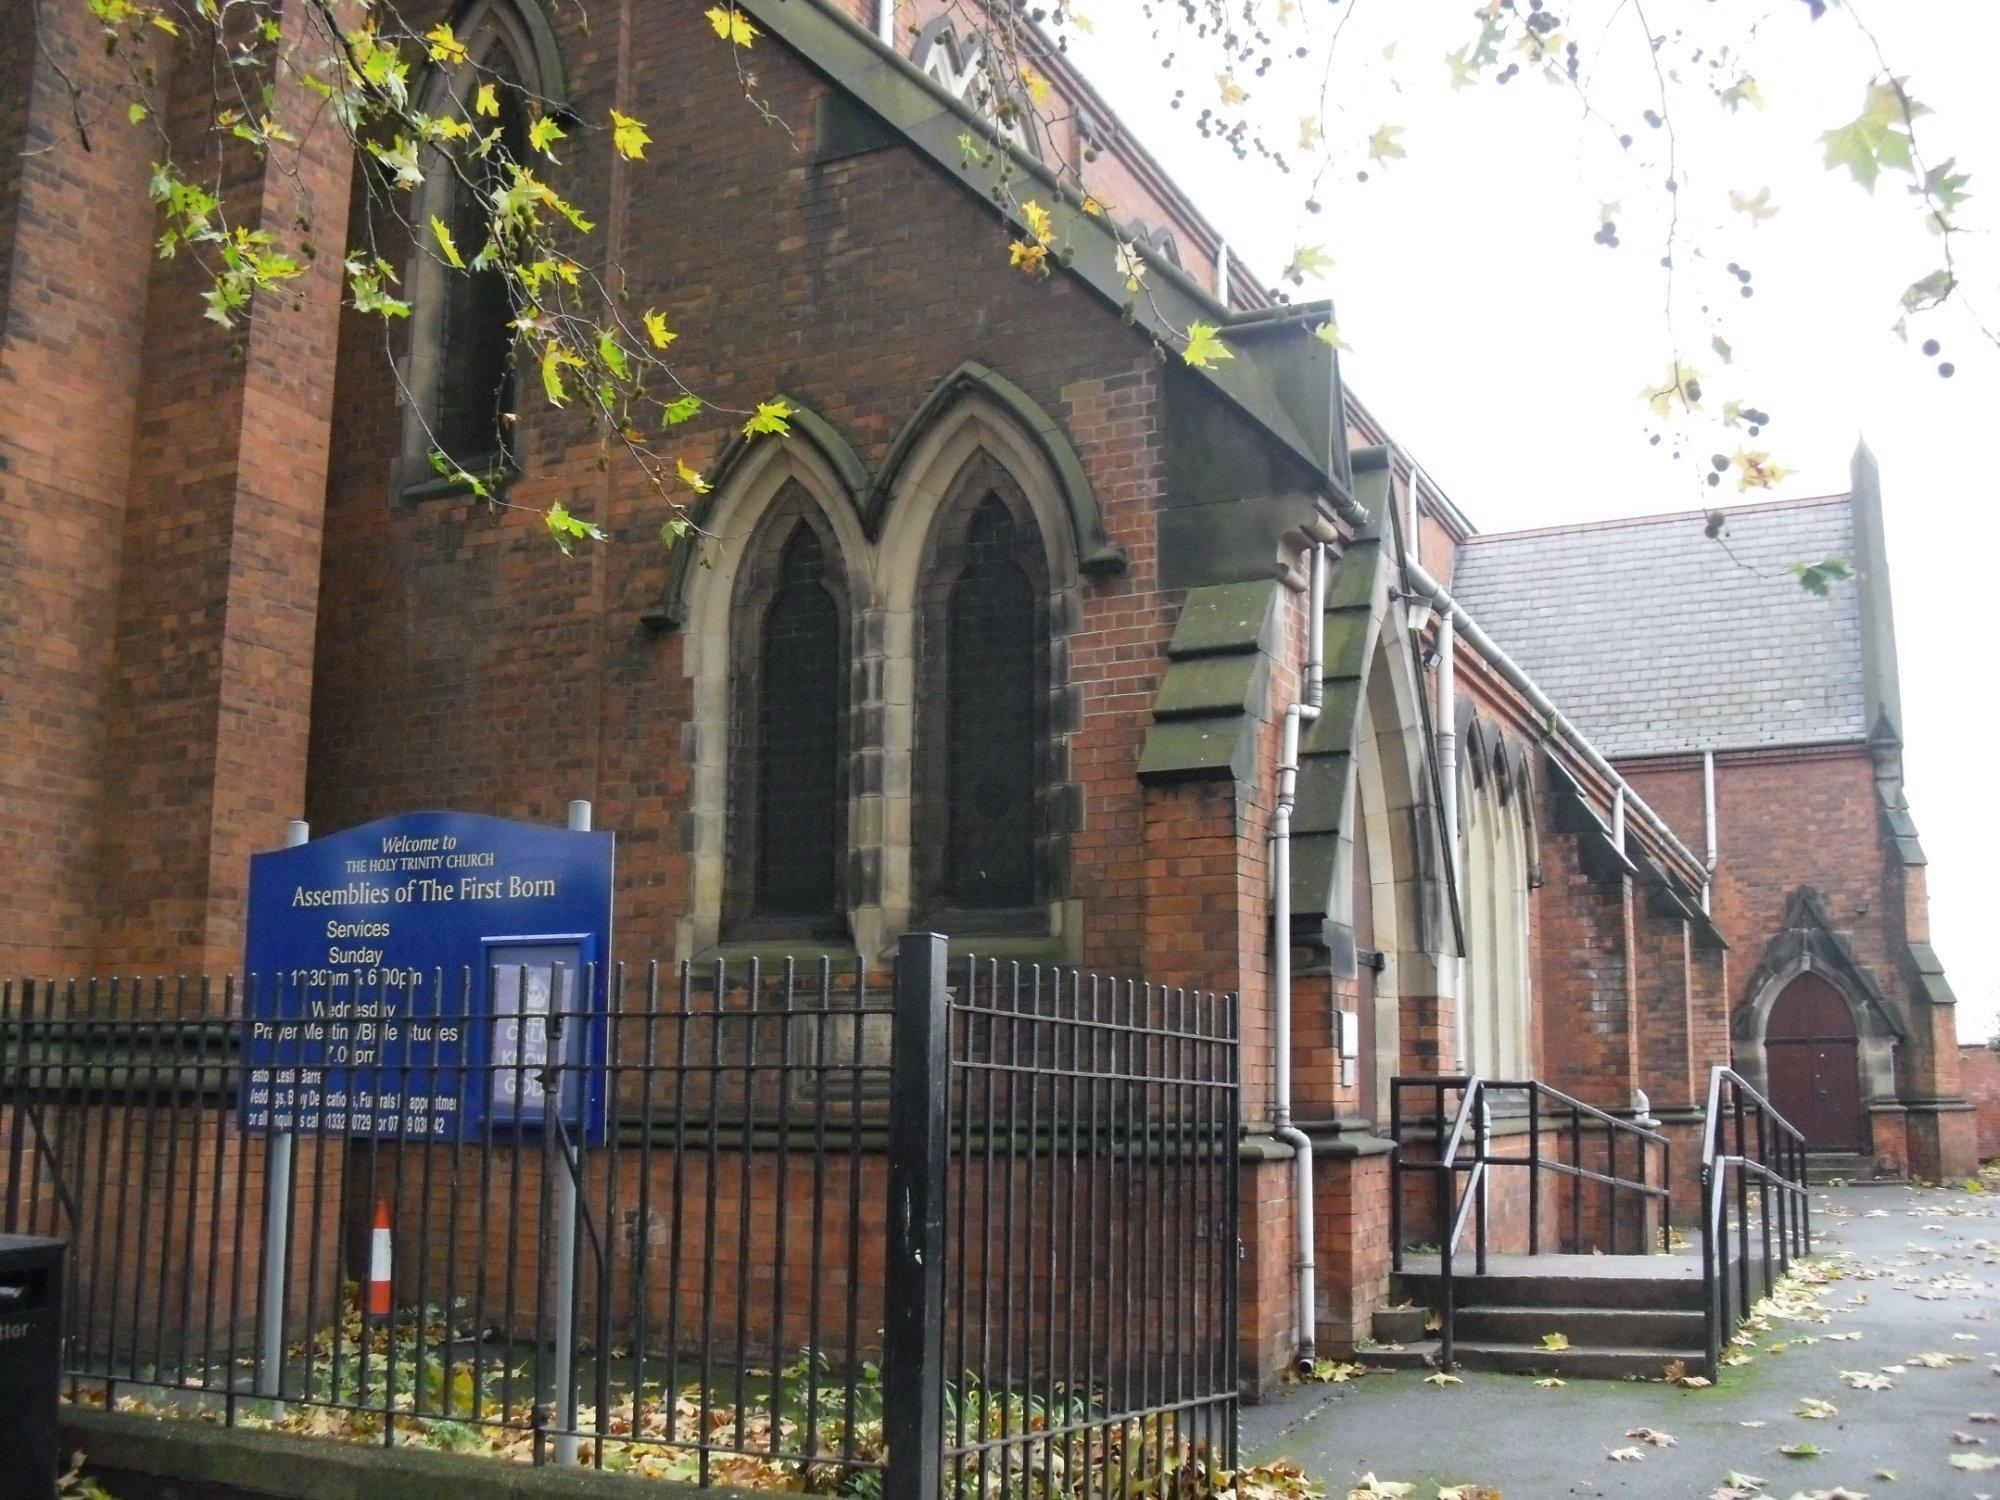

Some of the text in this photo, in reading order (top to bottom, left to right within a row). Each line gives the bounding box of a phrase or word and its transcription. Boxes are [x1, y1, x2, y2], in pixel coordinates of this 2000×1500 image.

[382, 835, 457, 854] Welcome to
[345, 852, 495, 874] THE HOLY TRINITY CHURCH
[292, 876, 556, 907] Assemblies of The First Born
[327, 920, 390, 939] Services
[328, 946, 383, 967] Sunday
